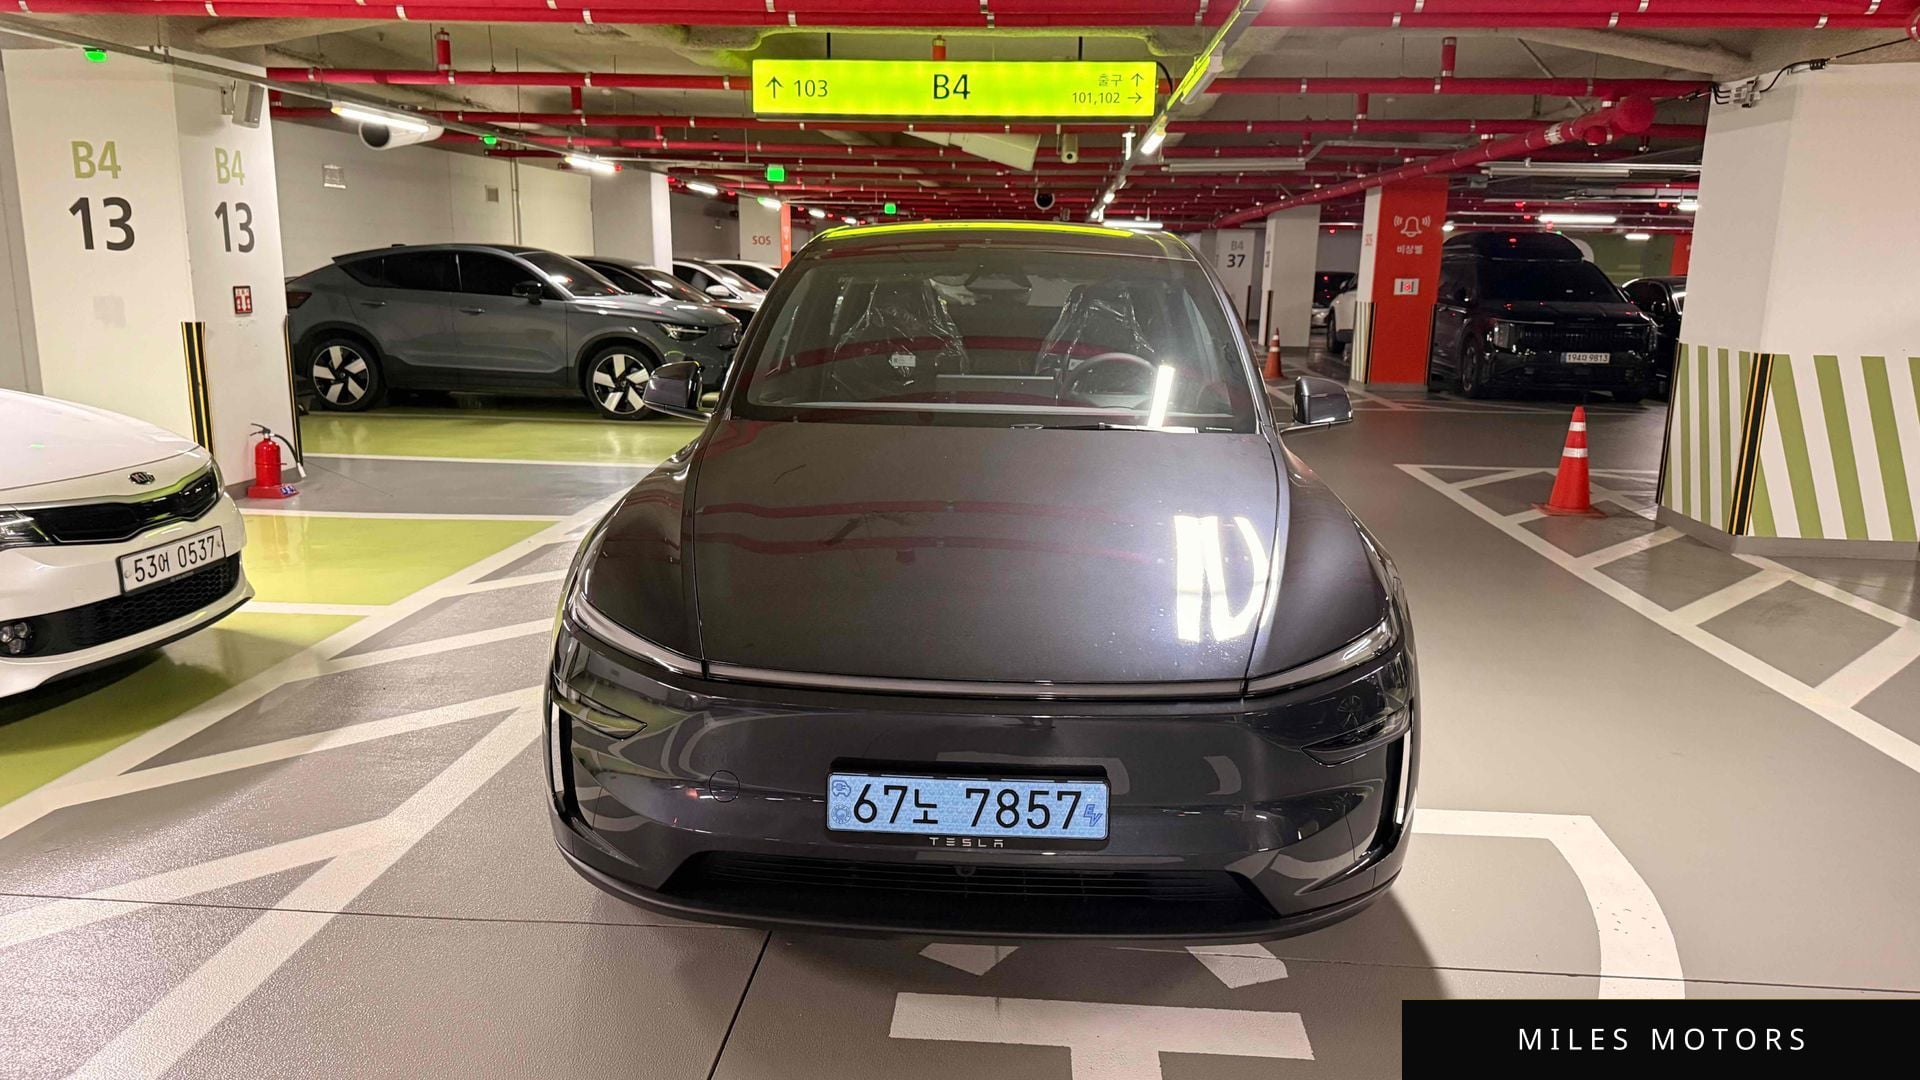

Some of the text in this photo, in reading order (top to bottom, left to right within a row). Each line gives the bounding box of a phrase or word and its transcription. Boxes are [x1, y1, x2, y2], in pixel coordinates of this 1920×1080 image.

[793, 79, 829, 98] 103
[932, 73, 971, 100] B4
[1098, 73, 1123, 87] 출구
[1072, 91, 1121, 106] 101,102
[71, 140, 122, 179] B4
[214, 147, 245, 186] B4
[68, 196, 135, 251] 13
[214, 201, 255, 253] 13
[752, 235, 771, 245] SOS
[1231, 240, 1244, 251] B4
[1226, 253, 1246, 269] 37
[134, 535, 214, 582] 53어 0537
[853, 784, 1082, 829] 67노 7857
[1083, 804, 1102, 827] EV
[929, 837, 1004, 848] TESLA
